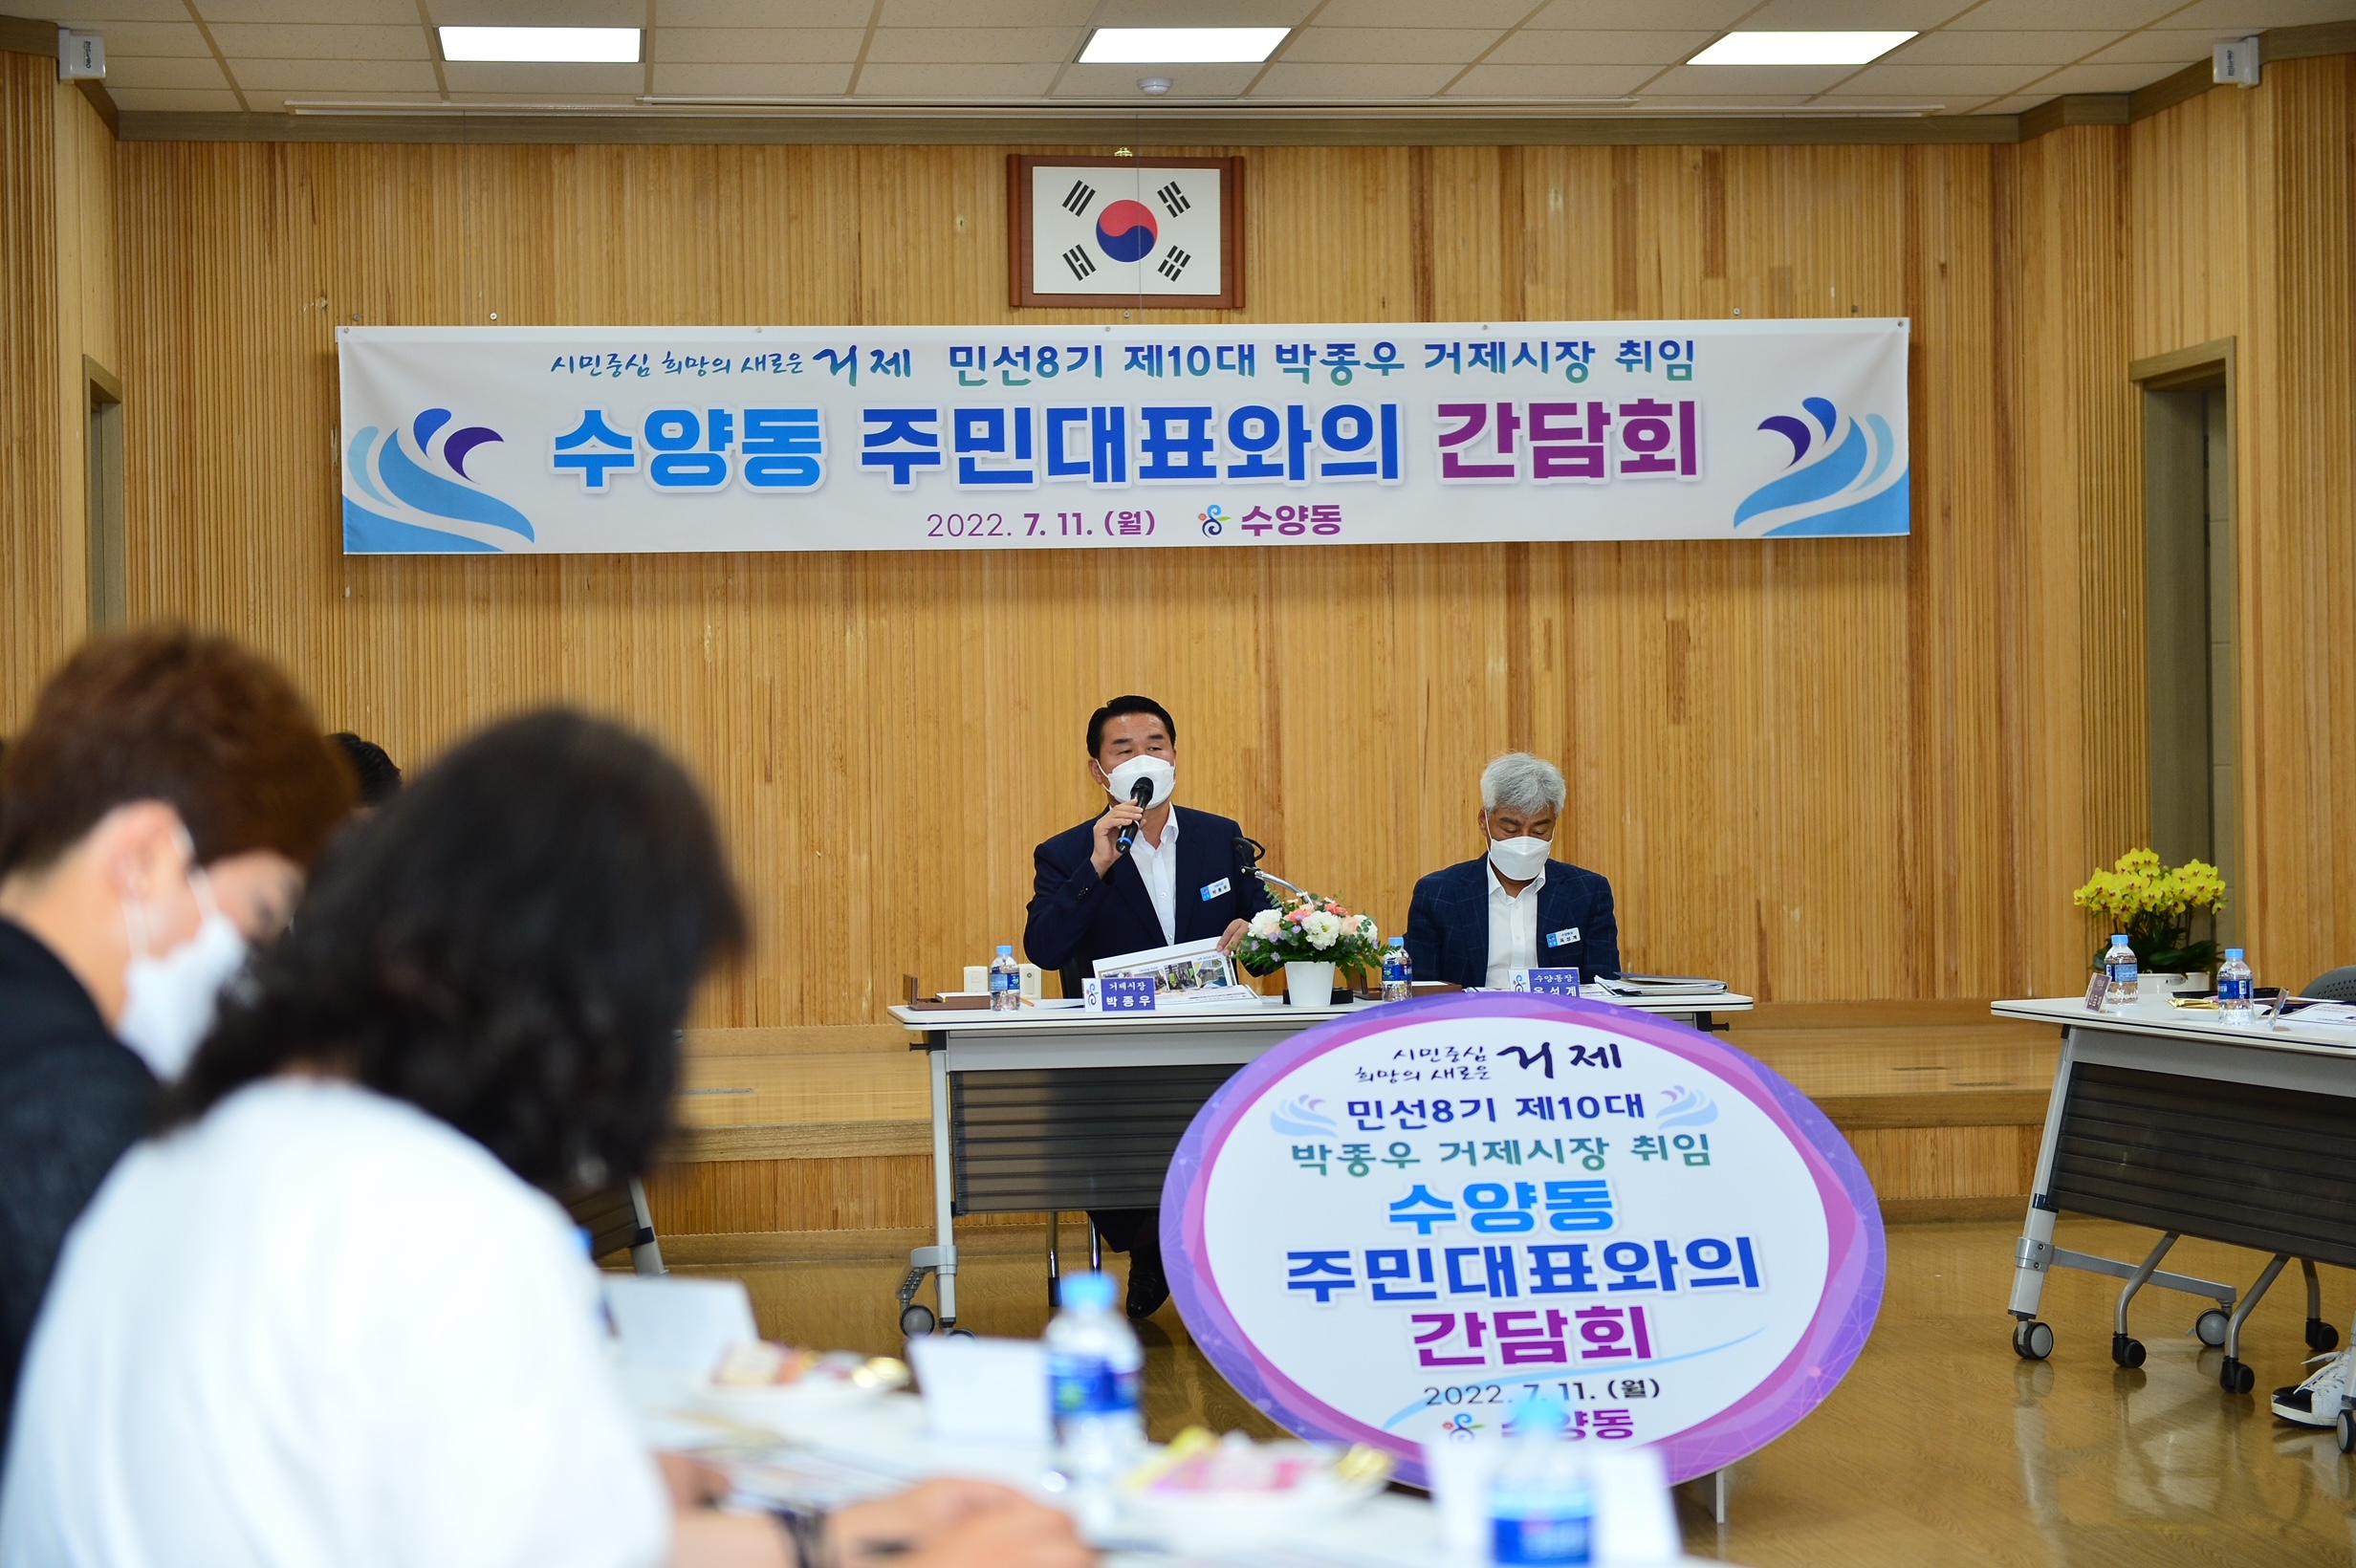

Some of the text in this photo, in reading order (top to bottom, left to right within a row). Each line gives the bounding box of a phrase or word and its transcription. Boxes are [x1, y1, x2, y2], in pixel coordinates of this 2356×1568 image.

[550, 339, 1694, 387] 시민중심 희망의 새로운 거제 민선8기 제10대 박종우 거제시장 취임
[553, 398, 1697, 488] 수양동 주민대표와의 간담회
[927, 510, 1155, 537] 2022. 7. 11. (월)
[1241, 504, 1342, 537] 수양동
[1108, 981, 1146, 992] 거제시장
[1534, 973, 1574, 983] 수양동장
[1105, 995, 1151, 1009] 박종우
[1393, 1045, 1486, 1063] 시민중심
[1495, 1041, 1623, 1079] 거제
[1355, 1065, 1490, 1084] 희망의 새로운
[1347, 1093, 1645, 1132] 민선8기 제10대
[1292, 1133, 1711, 1178] 박종우 거제시장 취임
[1388, 1179, 1614, 1235] 수양동
[1286, 1236, 1760, 1303] 주민대표와의
[1410, 1305, 1652, 1367] 간담회
[1424, 1383, 1513, 1406] 2022.
[1558, 1382, 1596, 1401] 11.
[1607, 1378, 1661, 1400] (월)
